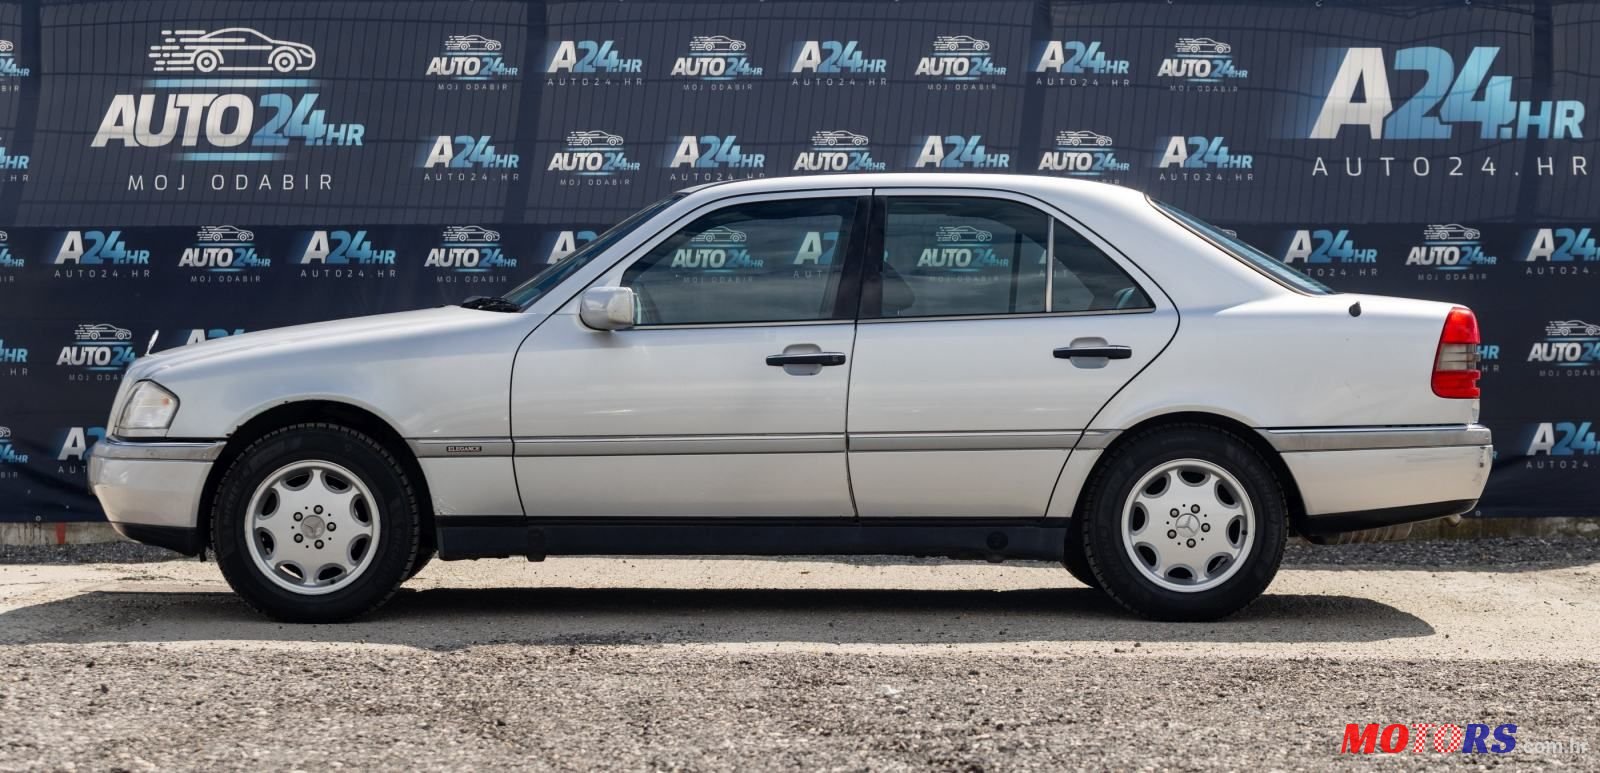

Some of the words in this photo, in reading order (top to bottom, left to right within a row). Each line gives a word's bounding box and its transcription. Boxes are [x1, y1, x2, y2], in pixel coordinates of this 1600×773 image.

[547, 40, 642, 73] A24.HR
[792, 40, 886, 73] A24.HR
[1036, 41, 1129, 74] A24.HR
[1309, 46, 1585, 139] A24.HR
[90, 93, 365, 147] AUTO24.HR
[424, 135, 519, 169] A24.HR
[670, 135, 765, 168] A24.HR
[915, 135, 1009, 168] A24.HR
[1160, 136, 1253, 168] A24.HR
[1312, 156, 1587, 177] AUTO24.HR
[128, 175, 186, 190] MOJ
[211, 174, 333, 190] ODABIR
[54, 230, 150, 264] A24.HR
[300, 230, 395, 264] A24.HR
[1282, 230, 1377, 263] A24.HR
[1306, 268, 1378, 276] TO24.HR
